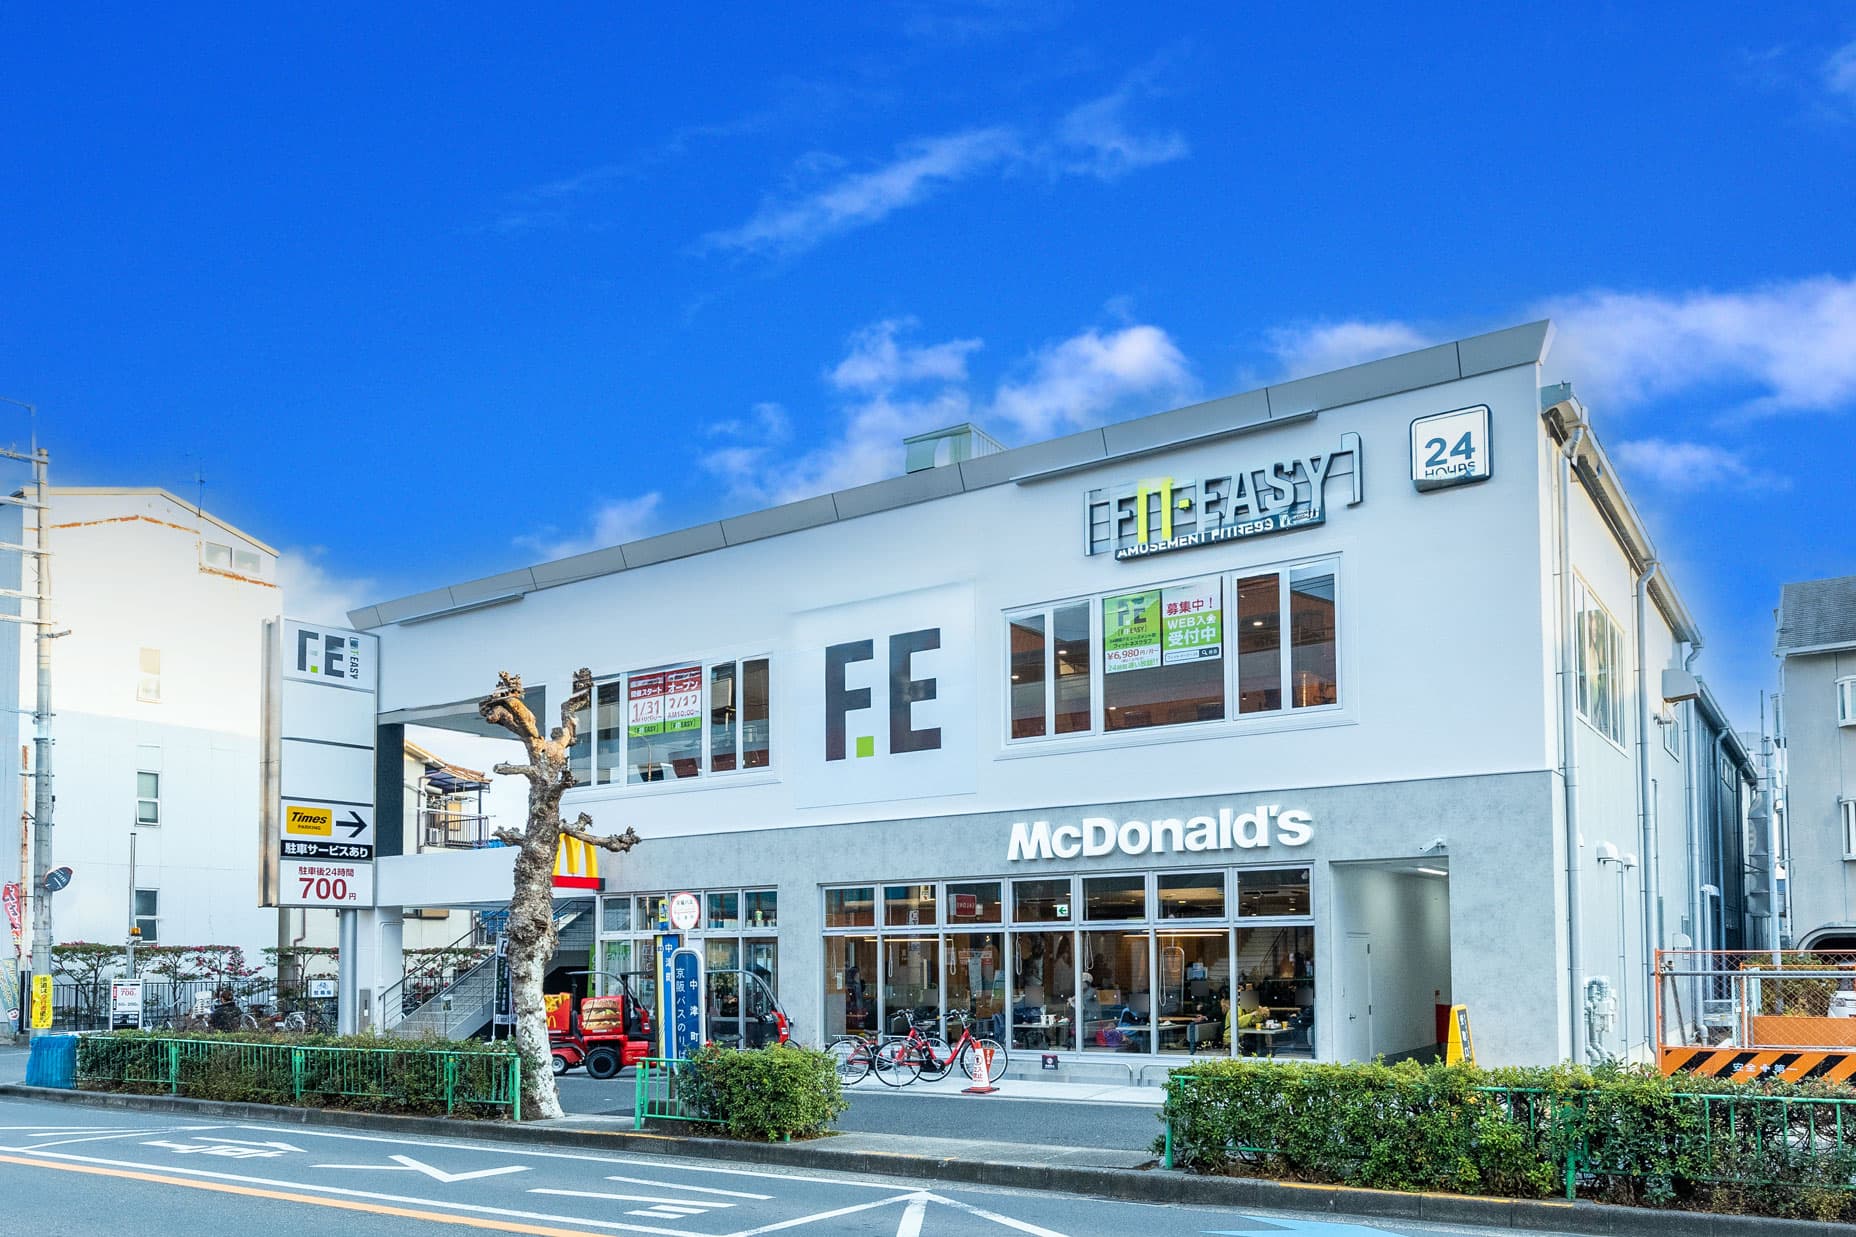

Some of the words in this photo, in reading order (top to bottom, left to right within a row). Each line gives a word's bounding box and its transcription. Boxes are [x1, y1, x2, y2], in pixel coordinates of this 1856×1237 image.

[1425, 431, 1476, 468] 24
[1167, 614, 1217, 631] WEB入会
[1168, 627, 1217, 648] 受付中
[667, 681, 699, 694] オープン
[632, 700, 660, 722] 1/31
[291, 811, 328, 824] Times
[1007, 804, 1314, 861] McDonald's
[284, 842, 369, 858] 駐車サービスあり
[298, 866, 355, 877] 駐車後24時間
[675, 967, 687, 1060] 京阪バスのりば
[689, 978, 699, 1043] 中津町
